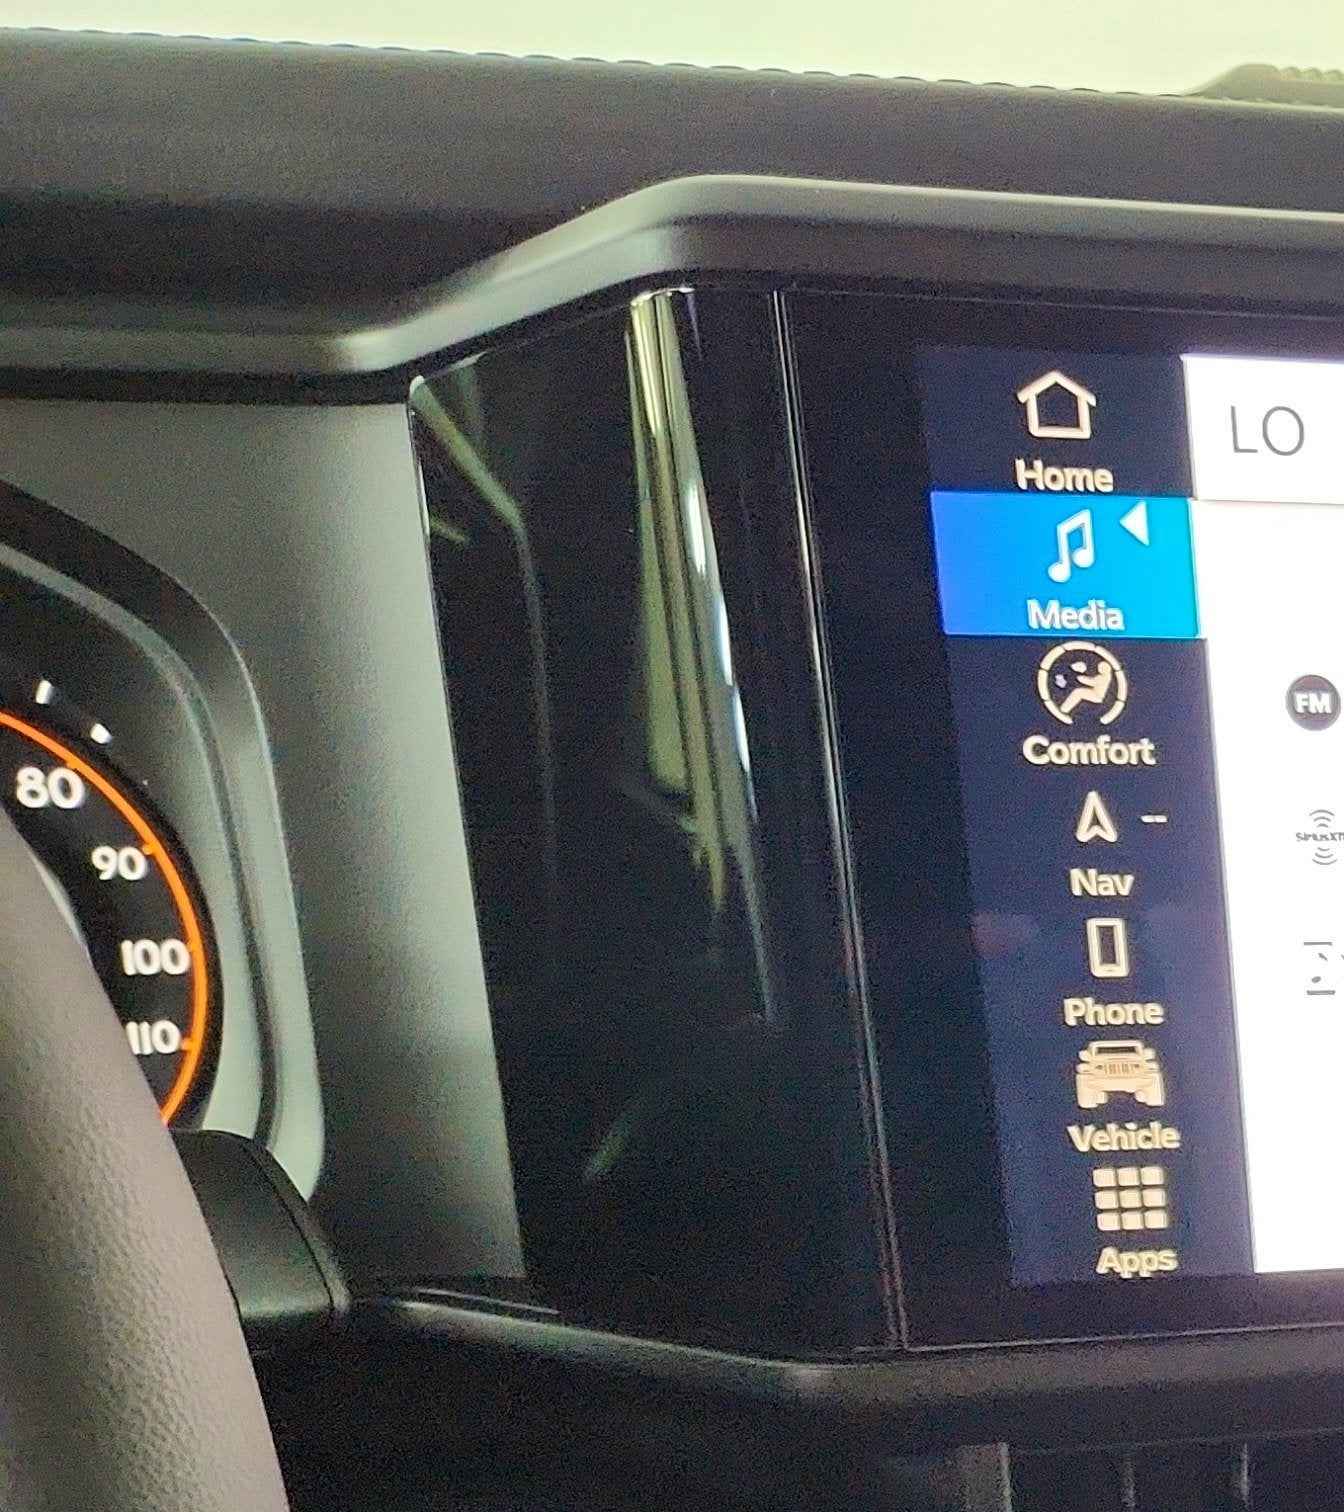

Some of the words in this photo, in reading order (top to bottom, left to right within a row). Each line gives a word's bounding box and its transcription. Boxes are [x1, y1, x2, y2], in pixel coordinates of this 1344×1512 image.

[1230, 406, 1305, 455] LO
[1017, 459, 1114, 494] Home
[1027, 601, 1125, 632] Media
[1295, 693, 1333, 715] FM
[1022, 736, 1157, 768] Comfort
[15, 767, 84, 809] 80
[92, 846, 149, 881] 90
[1070, 868, 1134, 898] Nav
[121, 939, 191, 977] 100
[1064, 998, 1164, 1027] Phone
[126, 1019, 182, 1056] 110
[1068, 1122, 1180, 1153] Vehicle
[1097, 1246, 1178, 1279] Apps
